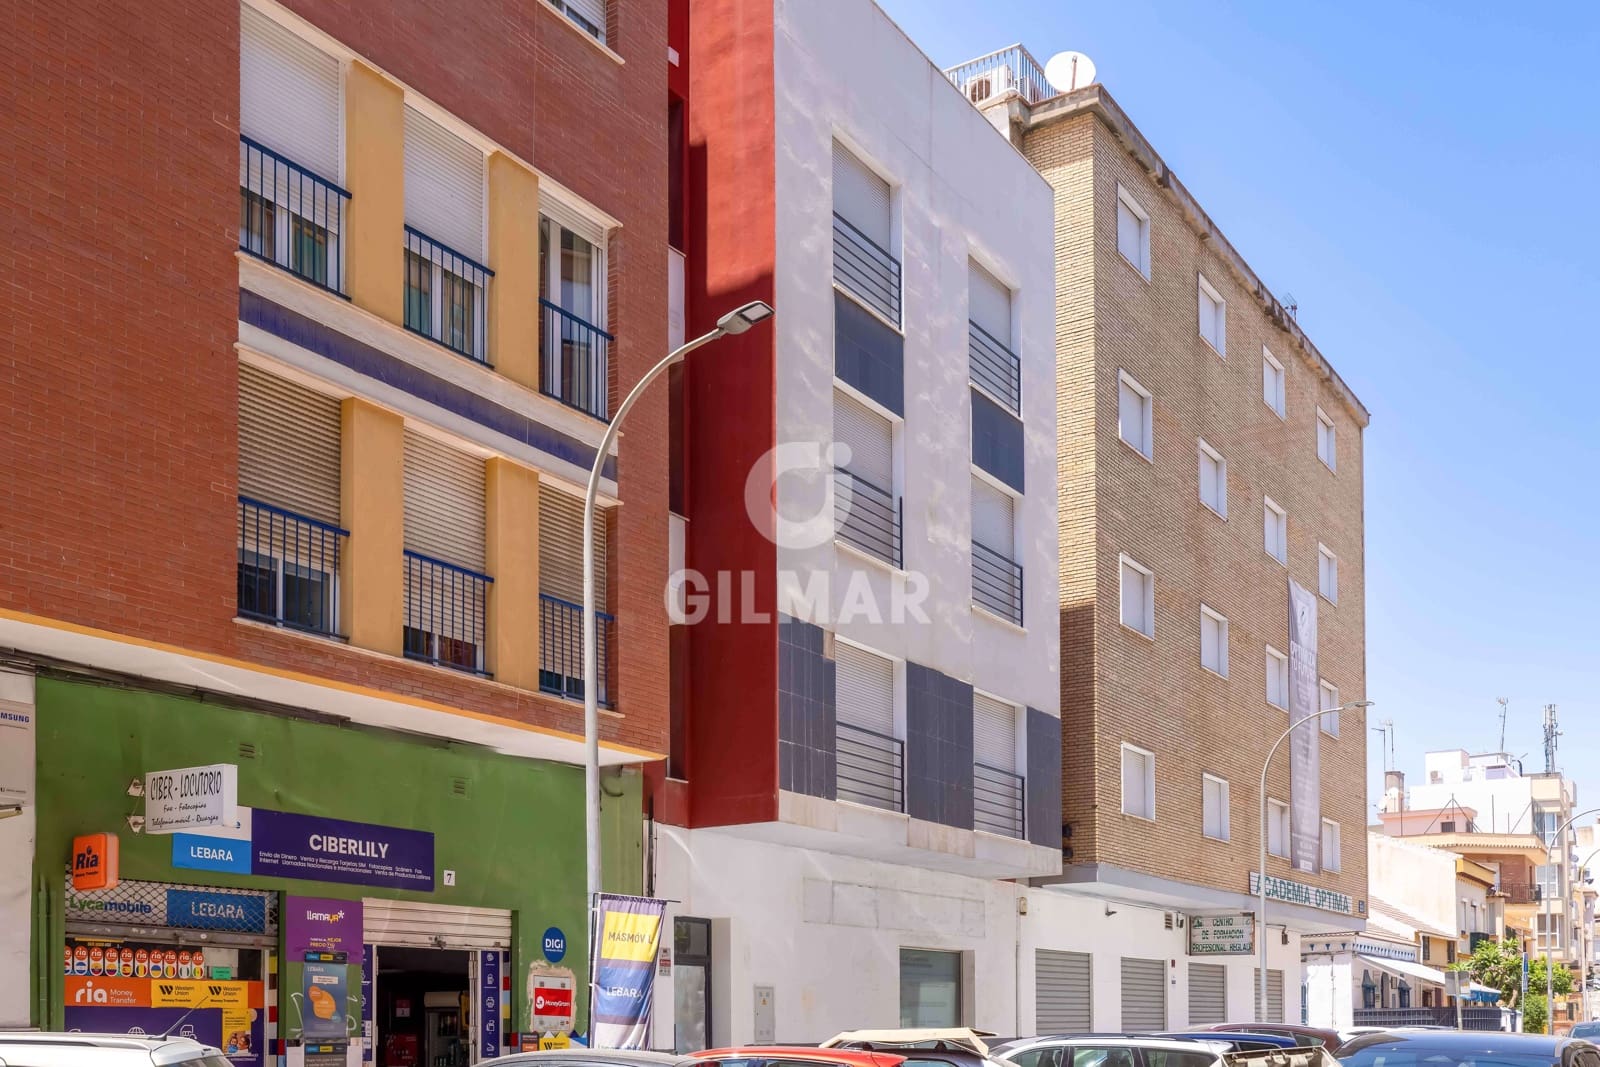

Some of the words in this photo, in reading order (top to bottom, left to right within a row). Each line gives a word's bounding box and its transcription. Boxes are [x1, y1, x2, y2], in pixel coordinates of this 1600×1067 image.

[0, 712, 30, 723] MSUNG
[150, 775, 173, 800] CIBER
[180, 770, 221, 798] LOCUTORIO
[179, 802, 207, 812] Fotocopias
[309, 834, 389, 859] CIBERLILY
[76, 845, 98, 870] Ria
[190, 846, 233, 861] LEBARA
[281, 853, 297, 861] Dinero
[447, 873, 452, 884] 7
[1256, 875, 1310, 904] ACADEMIA
[1315, 889, 1349, 913] OPTIMA
[69, 896, 151, 914] Lycamobile
[192, 901, 245, 920] LEBARA
[1212, 918, 1233, 927] CENTRO
[608, 931, 653, 944] MÁSMÓVL
[545, 939, 563, 949] DIGI
[75, 947, 87, 956] ria
[91, 948, 102, 957] ria
[121, 950, 132, 958] ria
[151, 951, 161, 959] ria
[75, 980, 107, 1003] ria
[110, 989, 133, 997] Money
[606, 985, 642, 998] LEBARA
